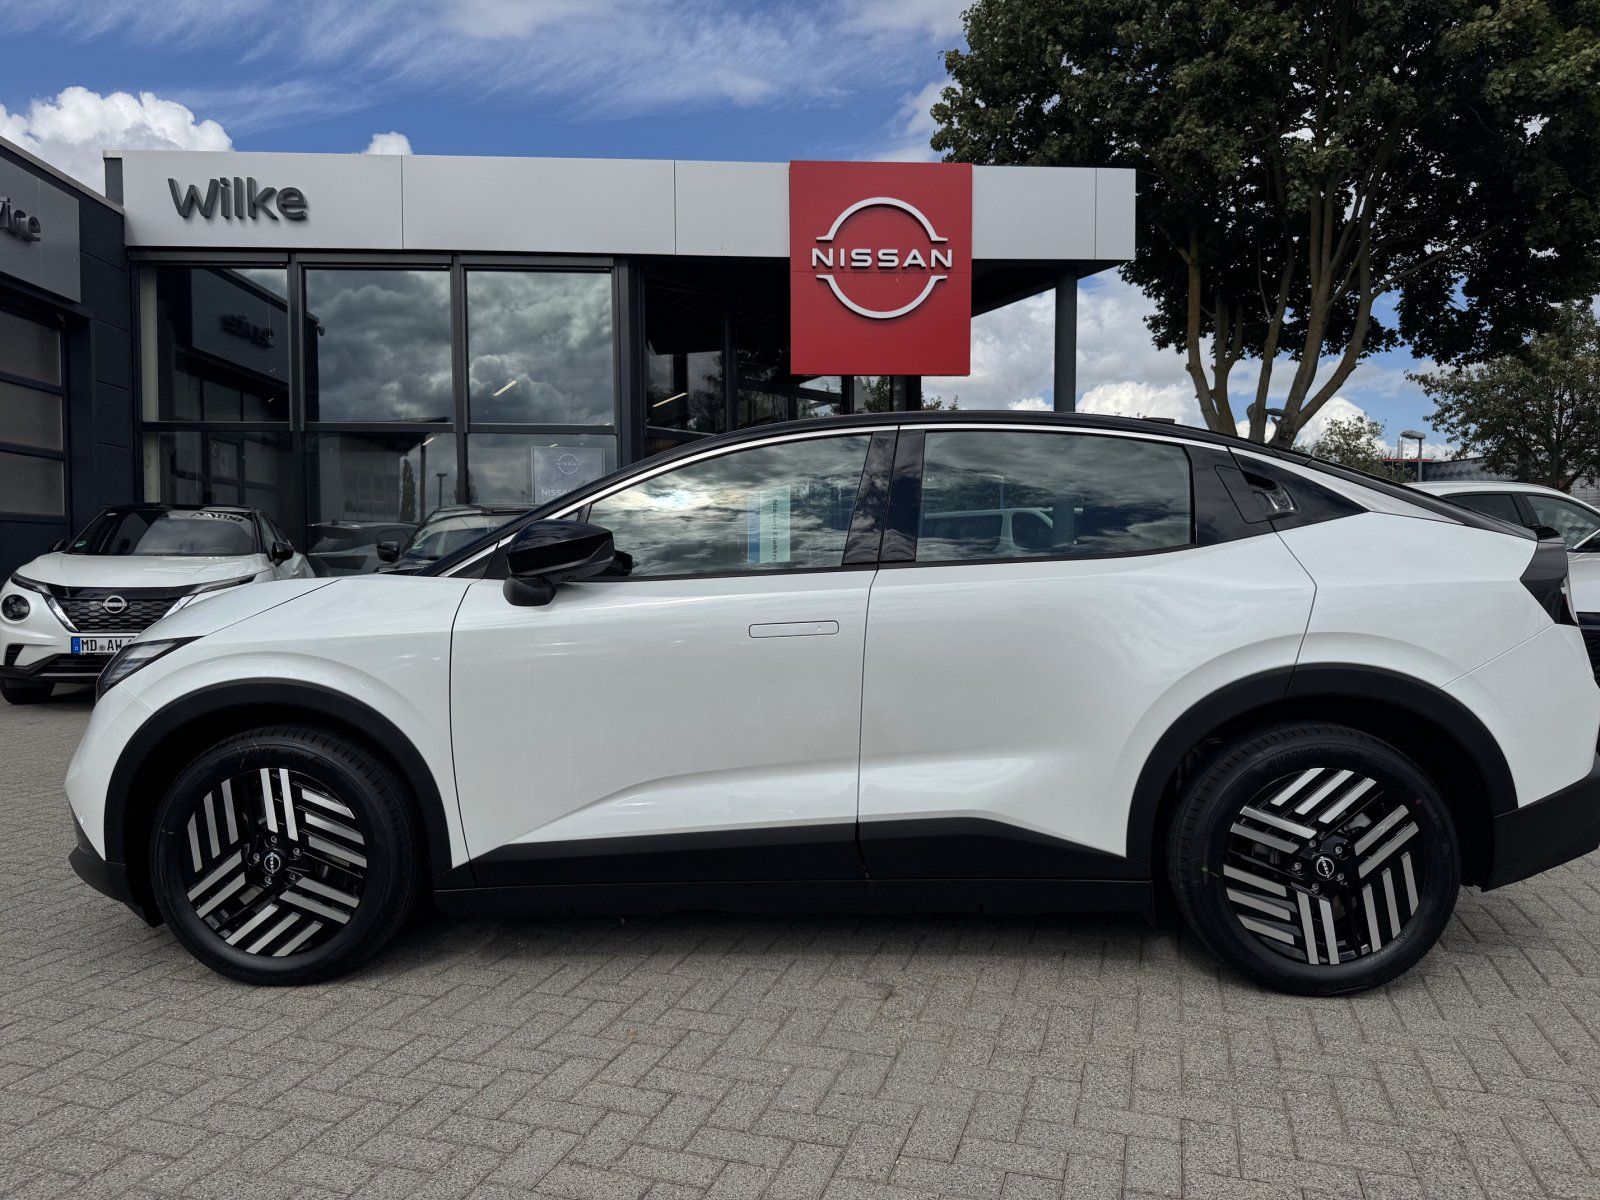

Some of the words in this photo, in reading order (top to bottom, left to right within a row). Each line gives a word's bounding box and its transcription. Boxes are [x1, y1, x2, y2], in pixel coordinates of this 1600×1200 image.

[167, 176, 308, 221] Wilke
[0, 196, 42, 242] ice
[811, 247, 953, 269] NISSAN
[81, 639, 97, 652] MD
[107, 639, 122, 652] AW
